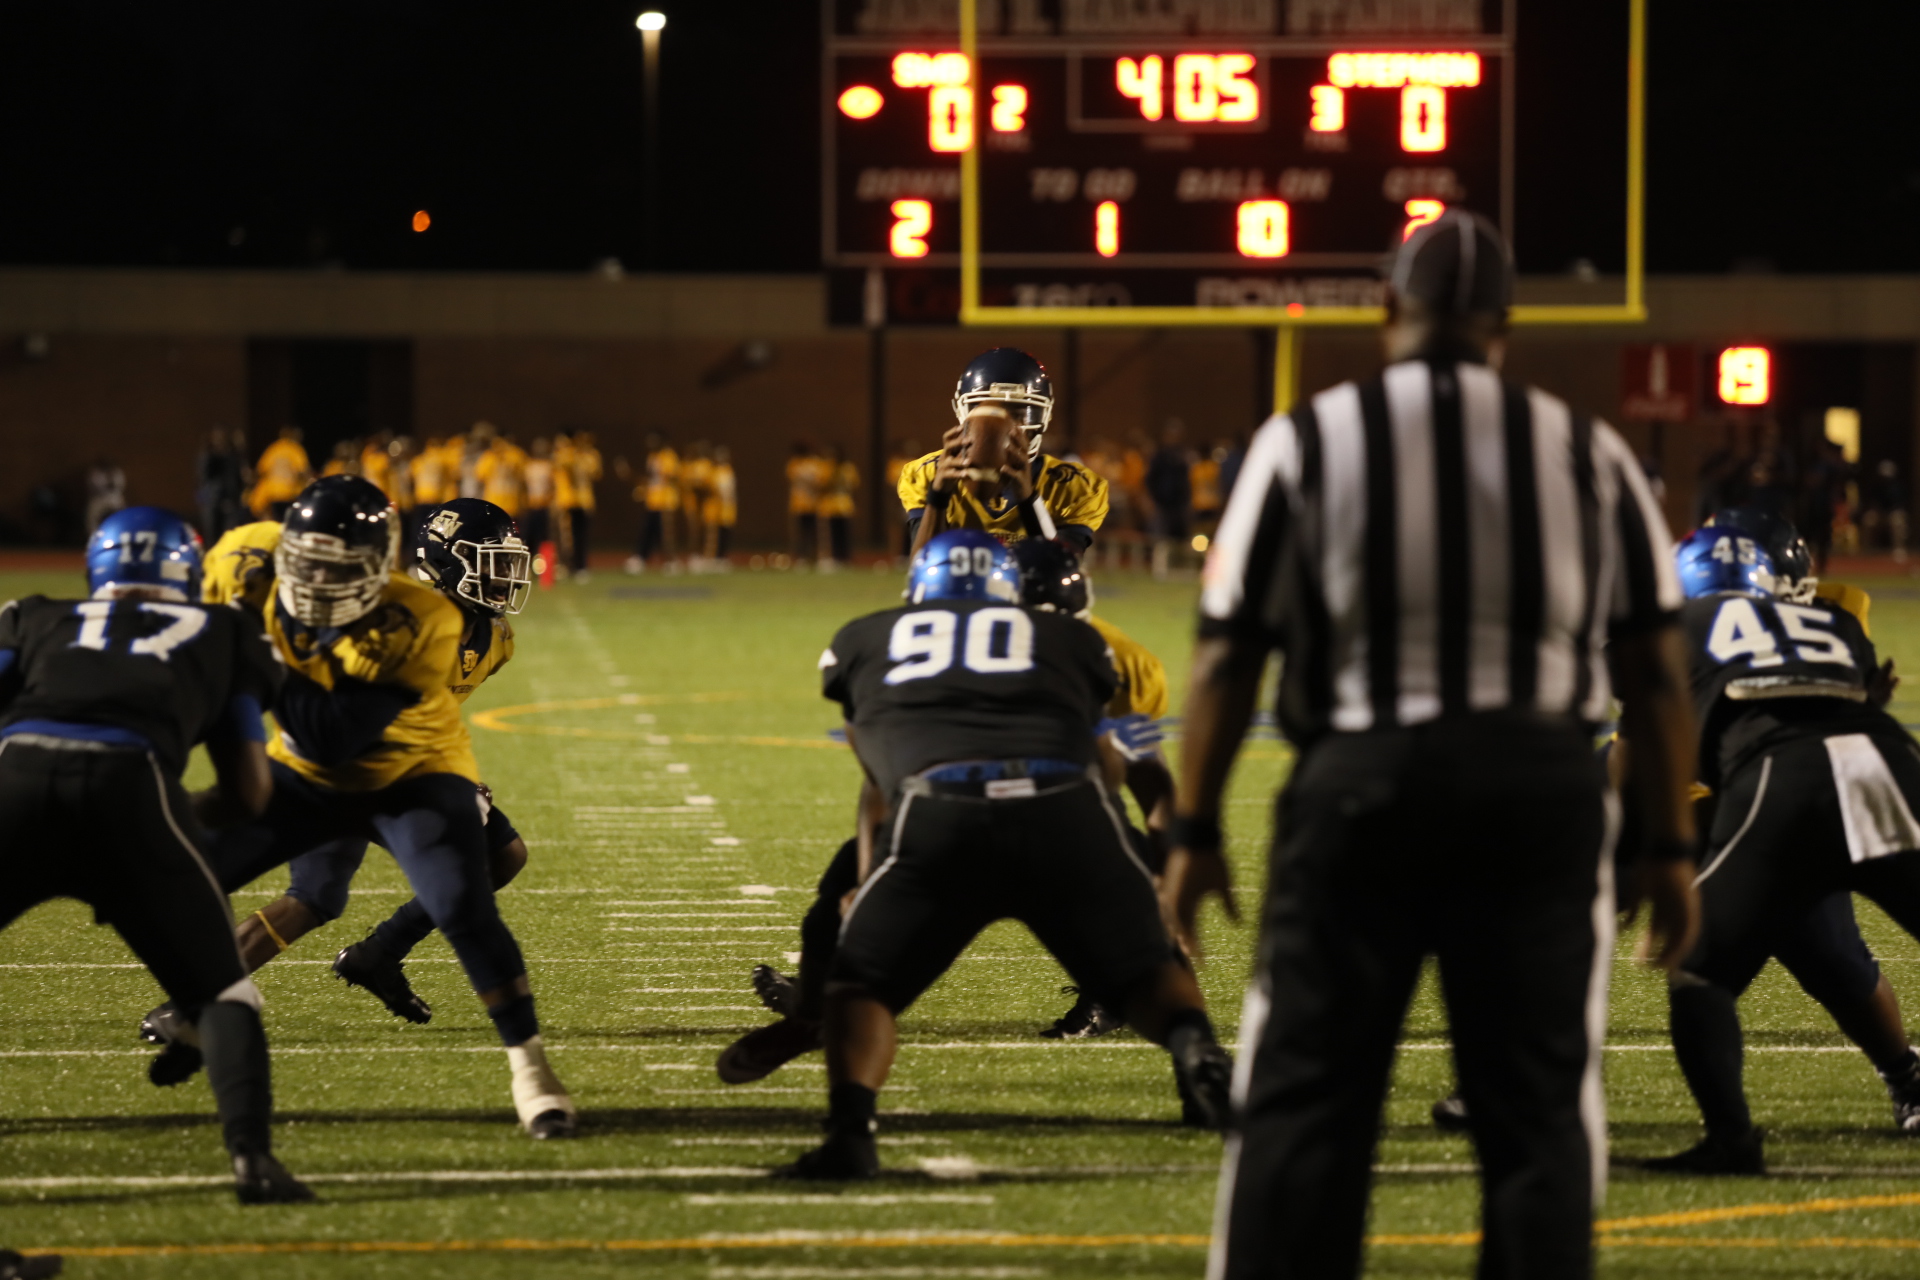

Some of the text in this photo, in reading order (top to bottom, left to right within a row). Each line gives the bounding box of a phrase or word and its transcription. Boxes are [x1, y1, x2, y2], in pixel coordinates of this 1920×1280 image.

[929, 85, 974, 152] 0
[991, 85, 1027, 131] 2
[1310, 85, 1344, 131] 3
[1400, 84, 1446, 152] 0
[890, 199, 932, 257] 2
[1096, 201, 1119, 257] 1
[119, 532, 158, 564] 17
[1712, 536, 1757, 564] 45
[76, 602, 208, 661] 17
[884, 607, 1034, 684] 90
[1707, 597, 1857, 668] 45
